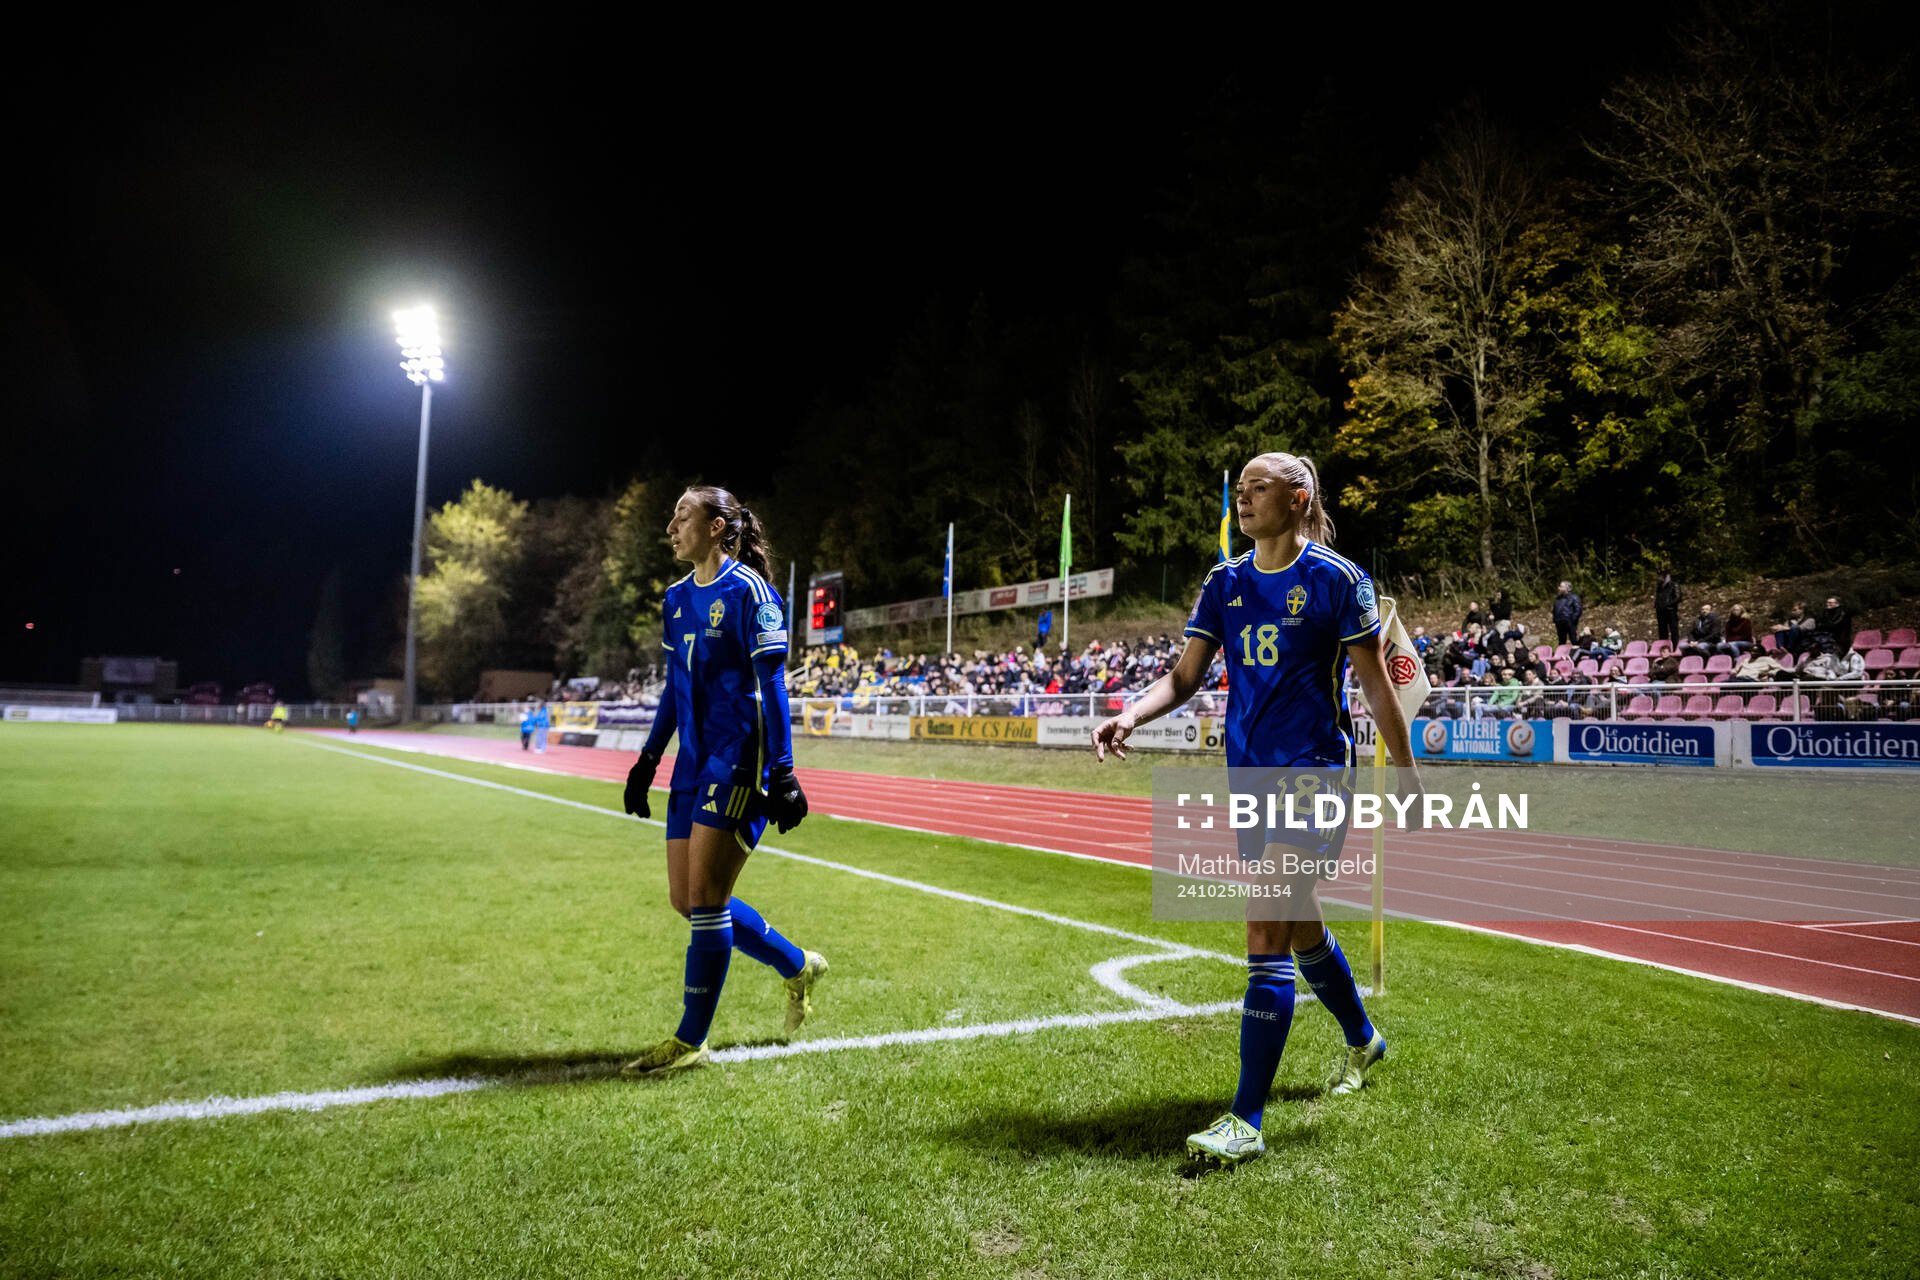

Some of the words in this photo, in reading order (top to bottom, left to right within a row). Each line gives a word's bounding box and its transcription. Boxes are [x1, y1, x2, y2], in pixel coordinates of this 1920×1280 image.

[684, 634, 696, 672] 7
[1240, 624, 1279, 666] 18
[959, 717, 977, 736] FC
[982, 717, 1000, 737] CS
[1004, 718, 1033, 738] Fola
[1453, 720, 1501, 739] LOTERIE
[1581, 725, 1700, 756] Quotidien
[1606, 727, 1618, 737] Le
[1798, 727, 1813, 738] Le
[1452, 740, 1501, 754] NATIONALE
[1767, 727, 1919, 761] Quotidien
[1276, 774, 1320, 815] 18
